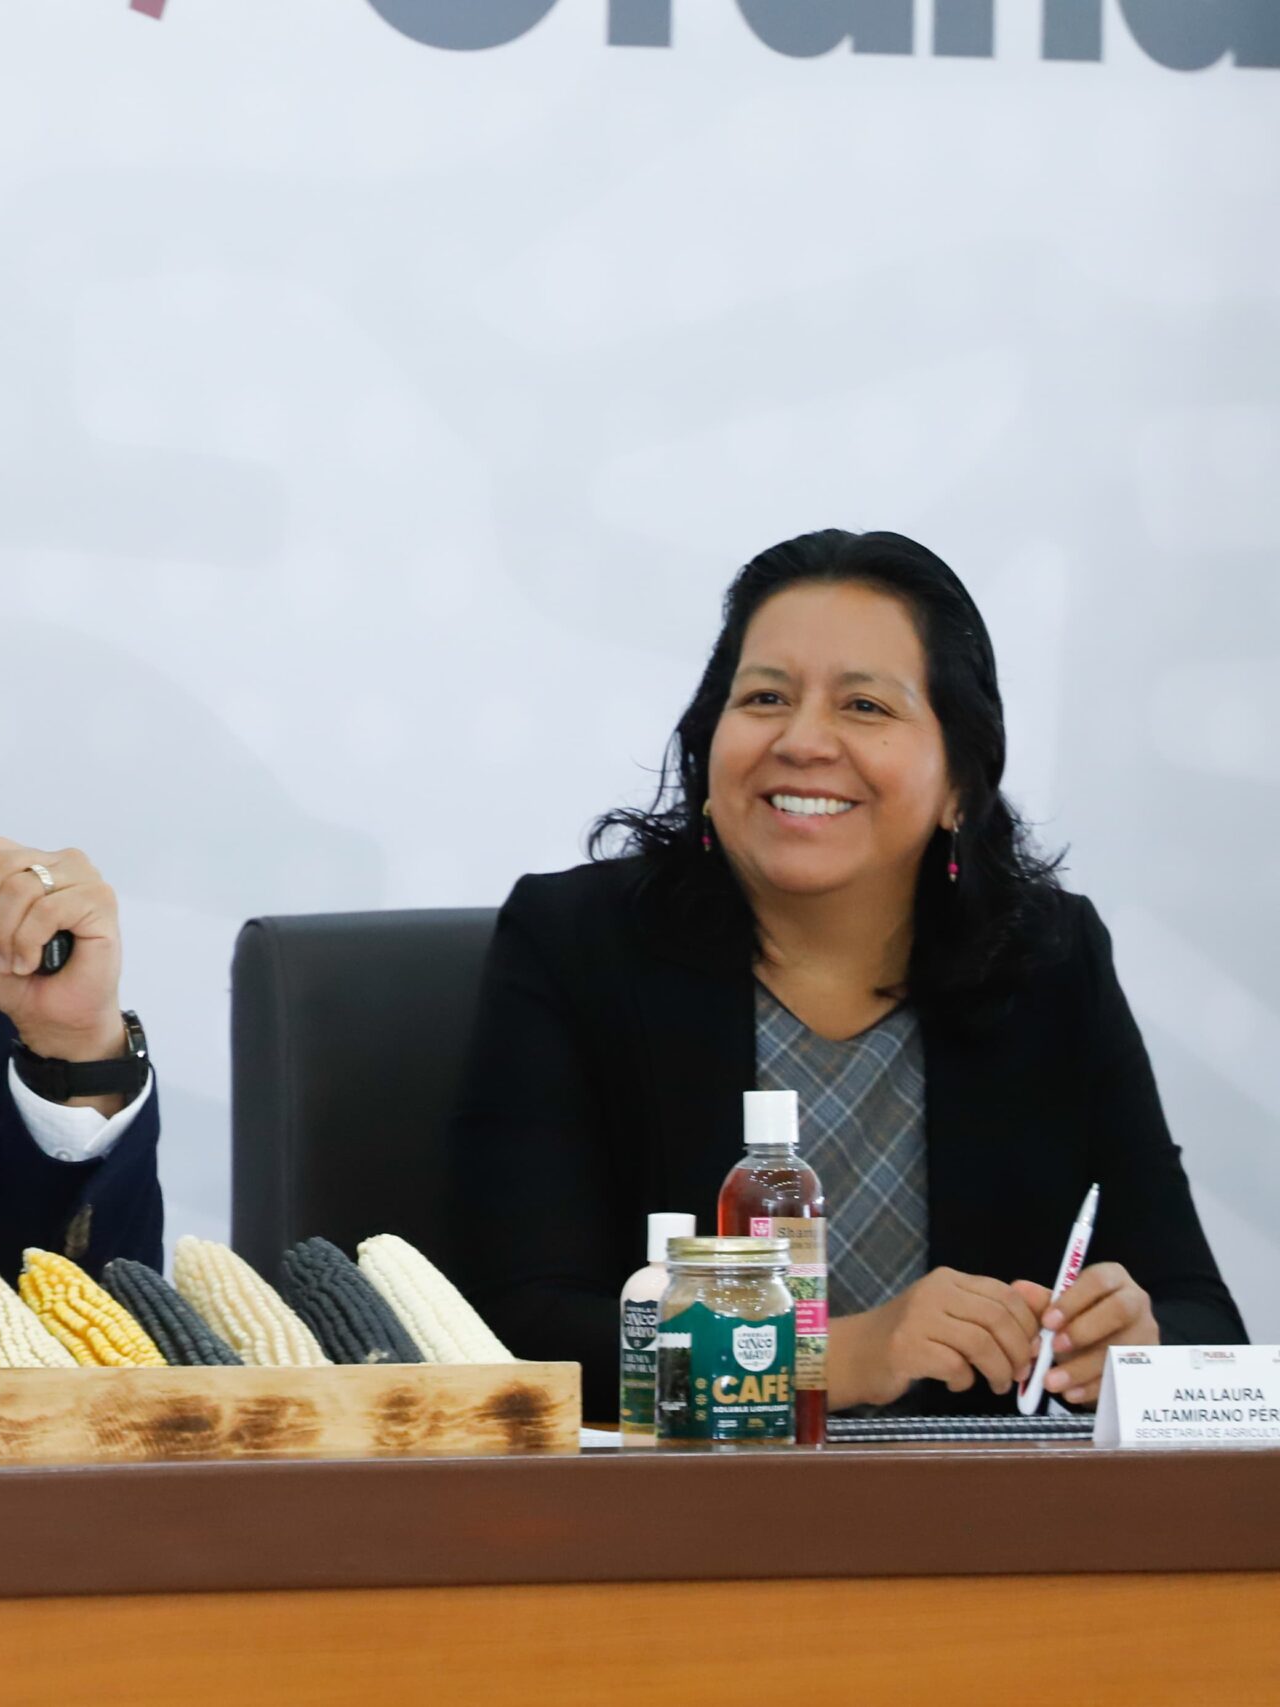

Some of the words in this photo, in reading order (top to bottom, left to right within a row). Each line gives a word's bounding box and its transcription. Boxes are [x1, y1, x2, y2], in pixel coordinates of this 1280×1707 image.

[712, 1366, 789, 1404] CAFÉ
[1174, 1388, 1206, 1401] ANA
[1211, 1388, 1264, 1401] LAURA
[1142, 1409, 1243, 1422] ALTAMIRANO
[1136, 1428, 1204, 1438] SECRETARIA
[1207, 1428, 1220, 1438] DE
